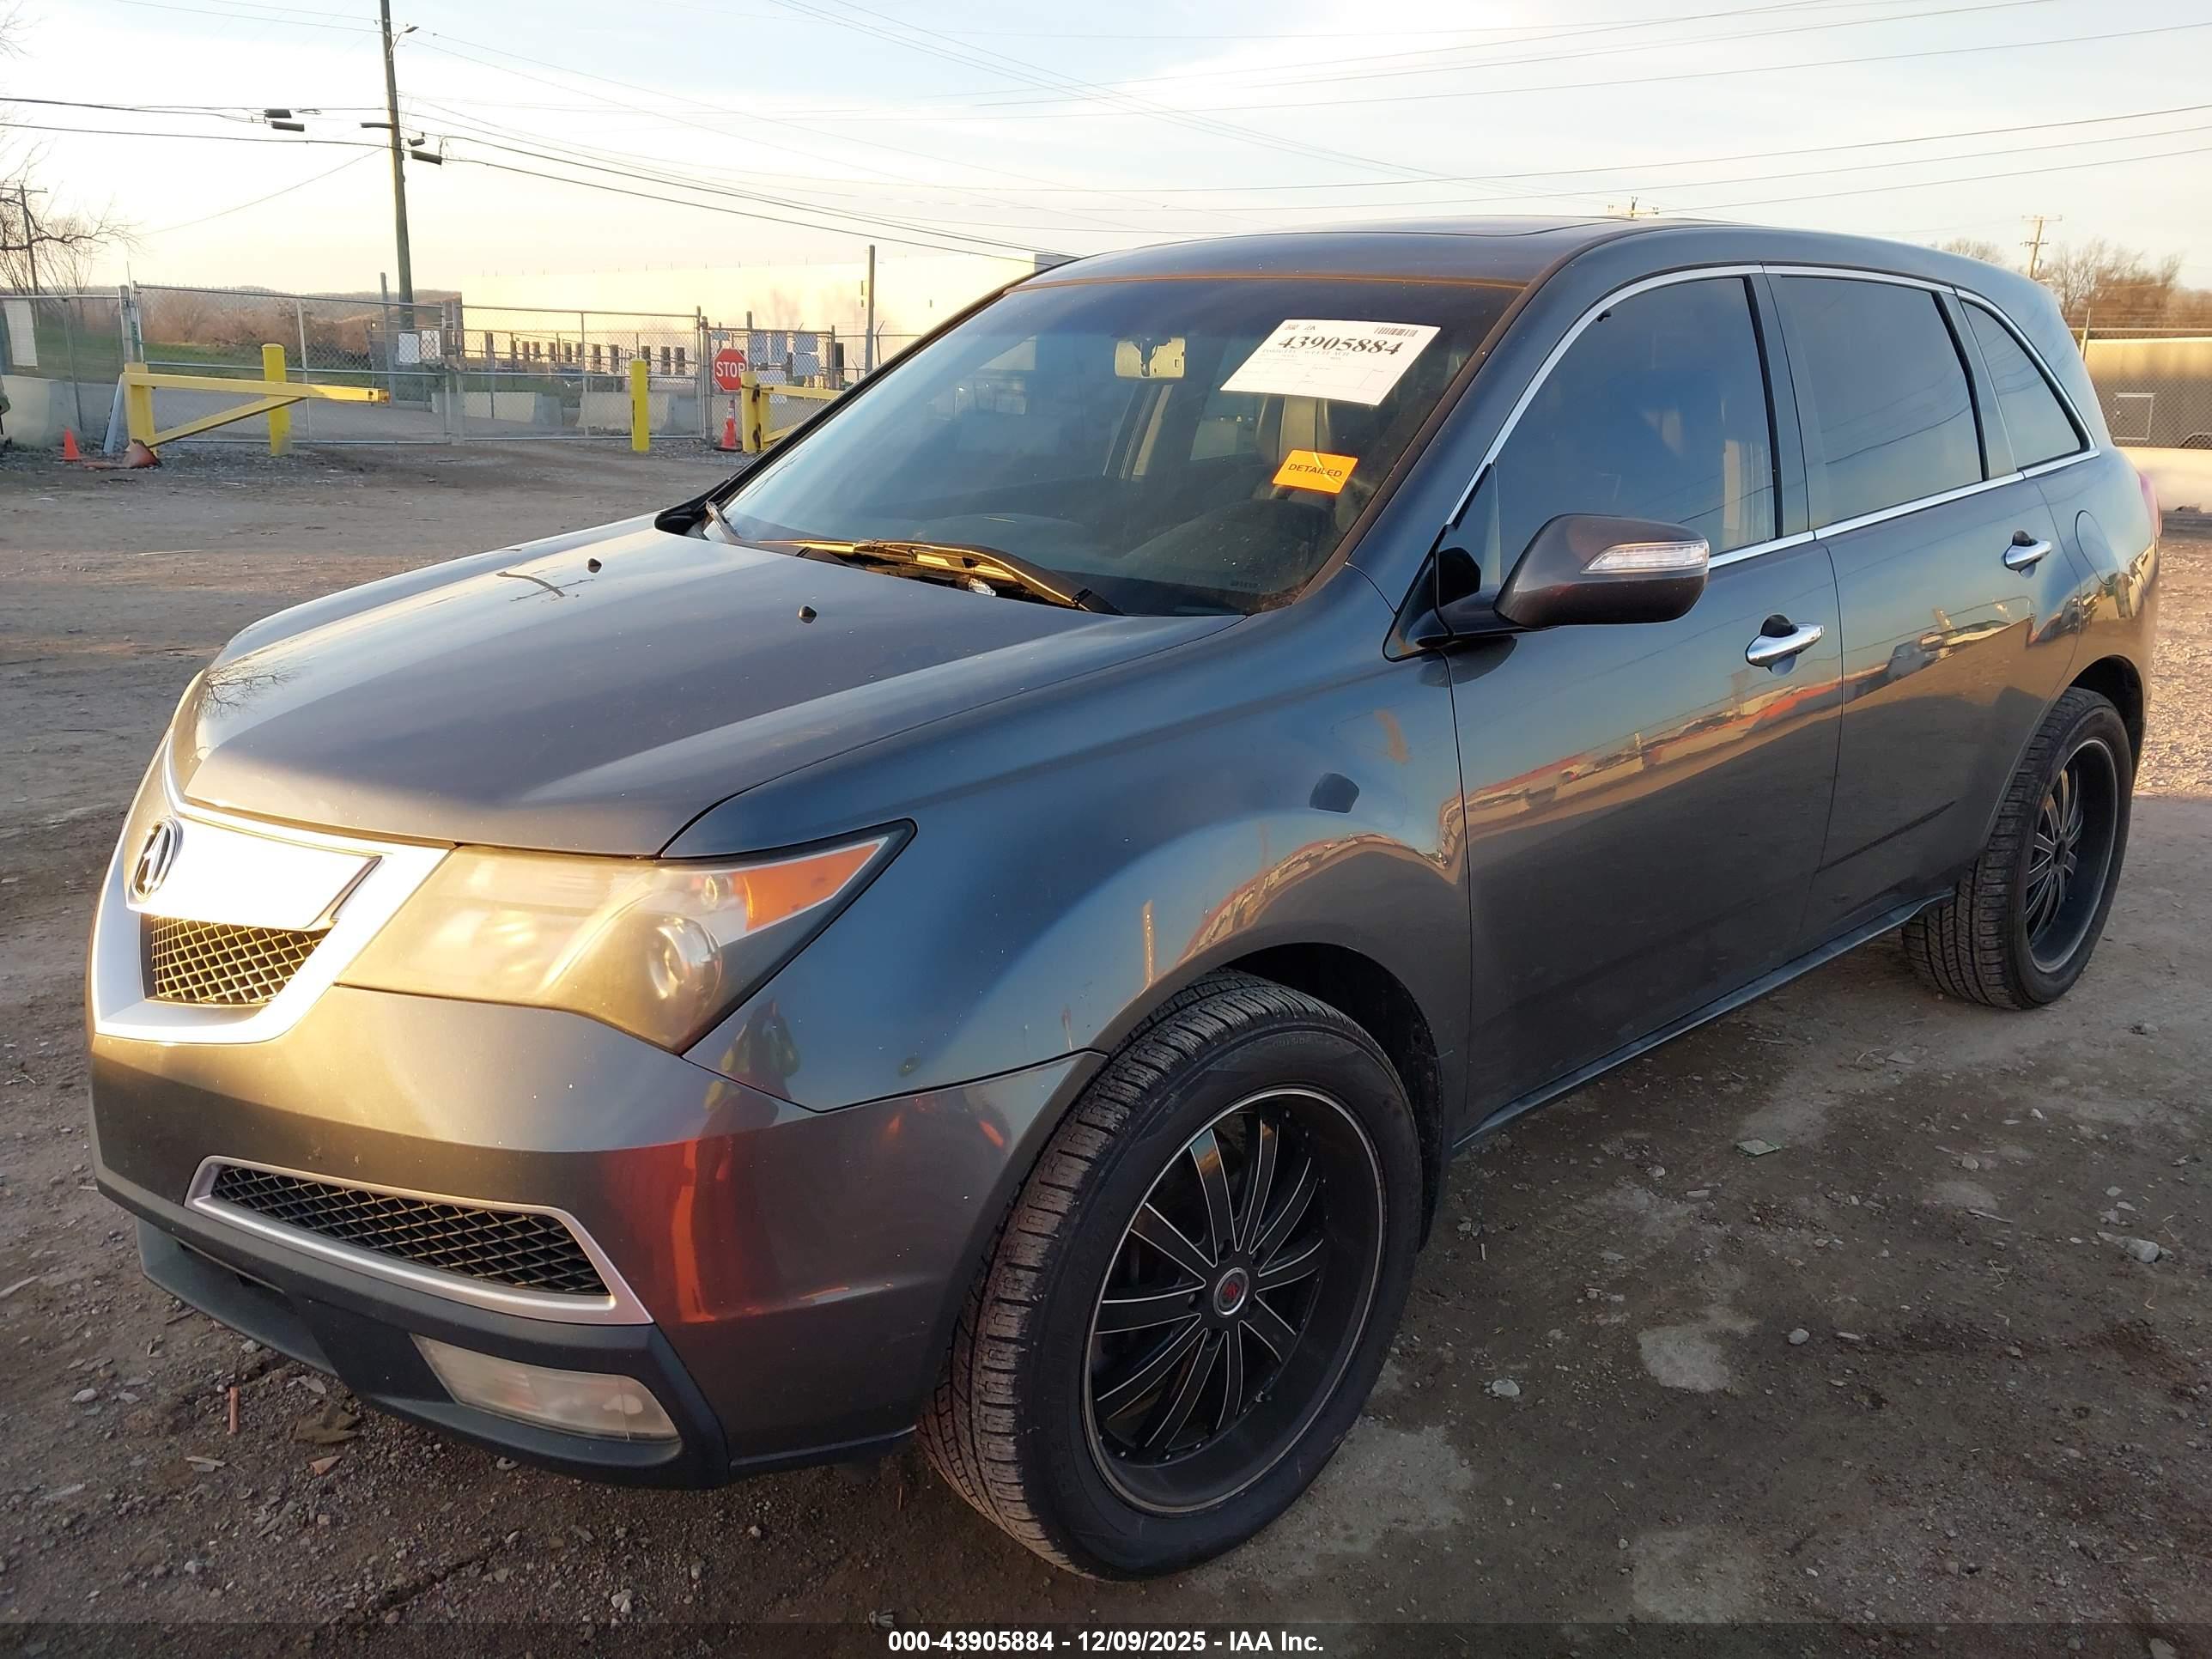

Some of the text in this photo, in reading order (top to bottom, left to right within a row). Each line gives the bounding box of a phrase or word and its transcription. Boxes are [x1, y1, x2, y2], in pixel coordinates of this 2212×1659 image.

[1278, 335, 1404, 356] 43905884
[715, 361, 745, 379] STOP
[1288, 464, 1343, 477] DETAILED
